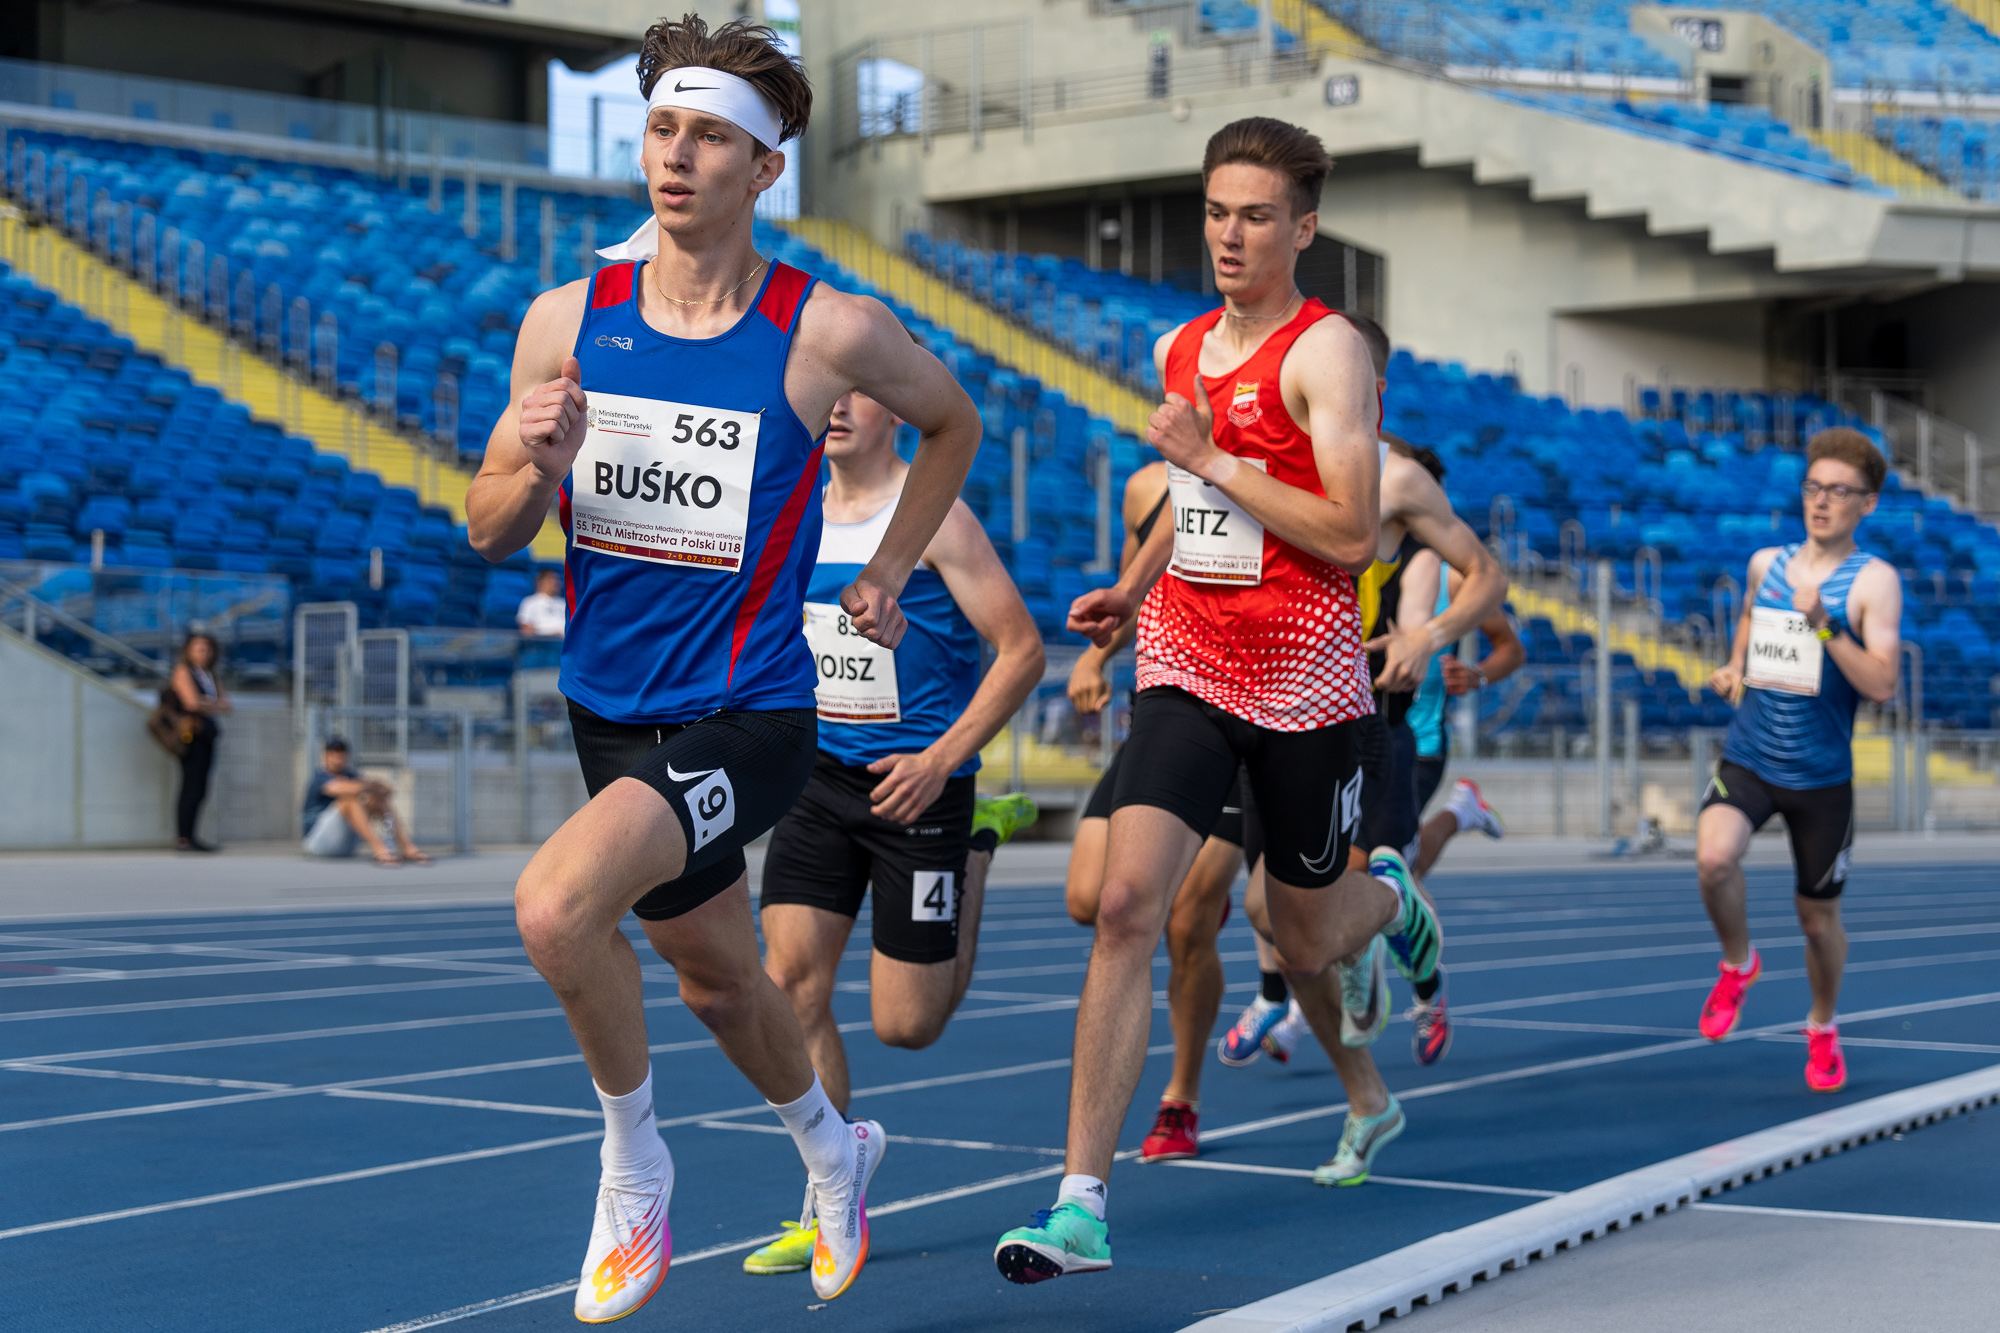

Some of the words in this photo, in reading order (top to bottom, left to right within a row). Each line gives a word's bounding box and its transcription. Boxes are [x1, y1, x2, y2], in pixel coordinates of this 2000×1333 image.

[597, 417, 618, 427] Sportu
[623, 420, 653, 431] Turystyki
[598, 409, 640, 421] Ministerstwo
[671, 413, 741, 450] 563
[594, 460, 722, 509] BUŚKO
[576, 519, 590, 532] 55.
[591, 522, 612, 537] PZLA
[614, 527, 678, 547] Mistrzostwa
[681, 536, 716, 551] Polski
[718, 541, 742, 553] U18
[587, 513, 622, 527] Ogólnopolska
[622, 520, 654, 530] Olimpiada
[654, 525, 687, 536] Młodzieży
[694, 529, 715, 540] lekkiej
[715, 532, 743, 542] atletyce
[591, 539, 627, 553] CHORZÓW
[667, 552, 723, 565] 7-9.07.2022
[1754, 642, 1799, 663] MIKA
[816, 653, 875, 681] OJSZ
[923, 875, 946, 916] 4
